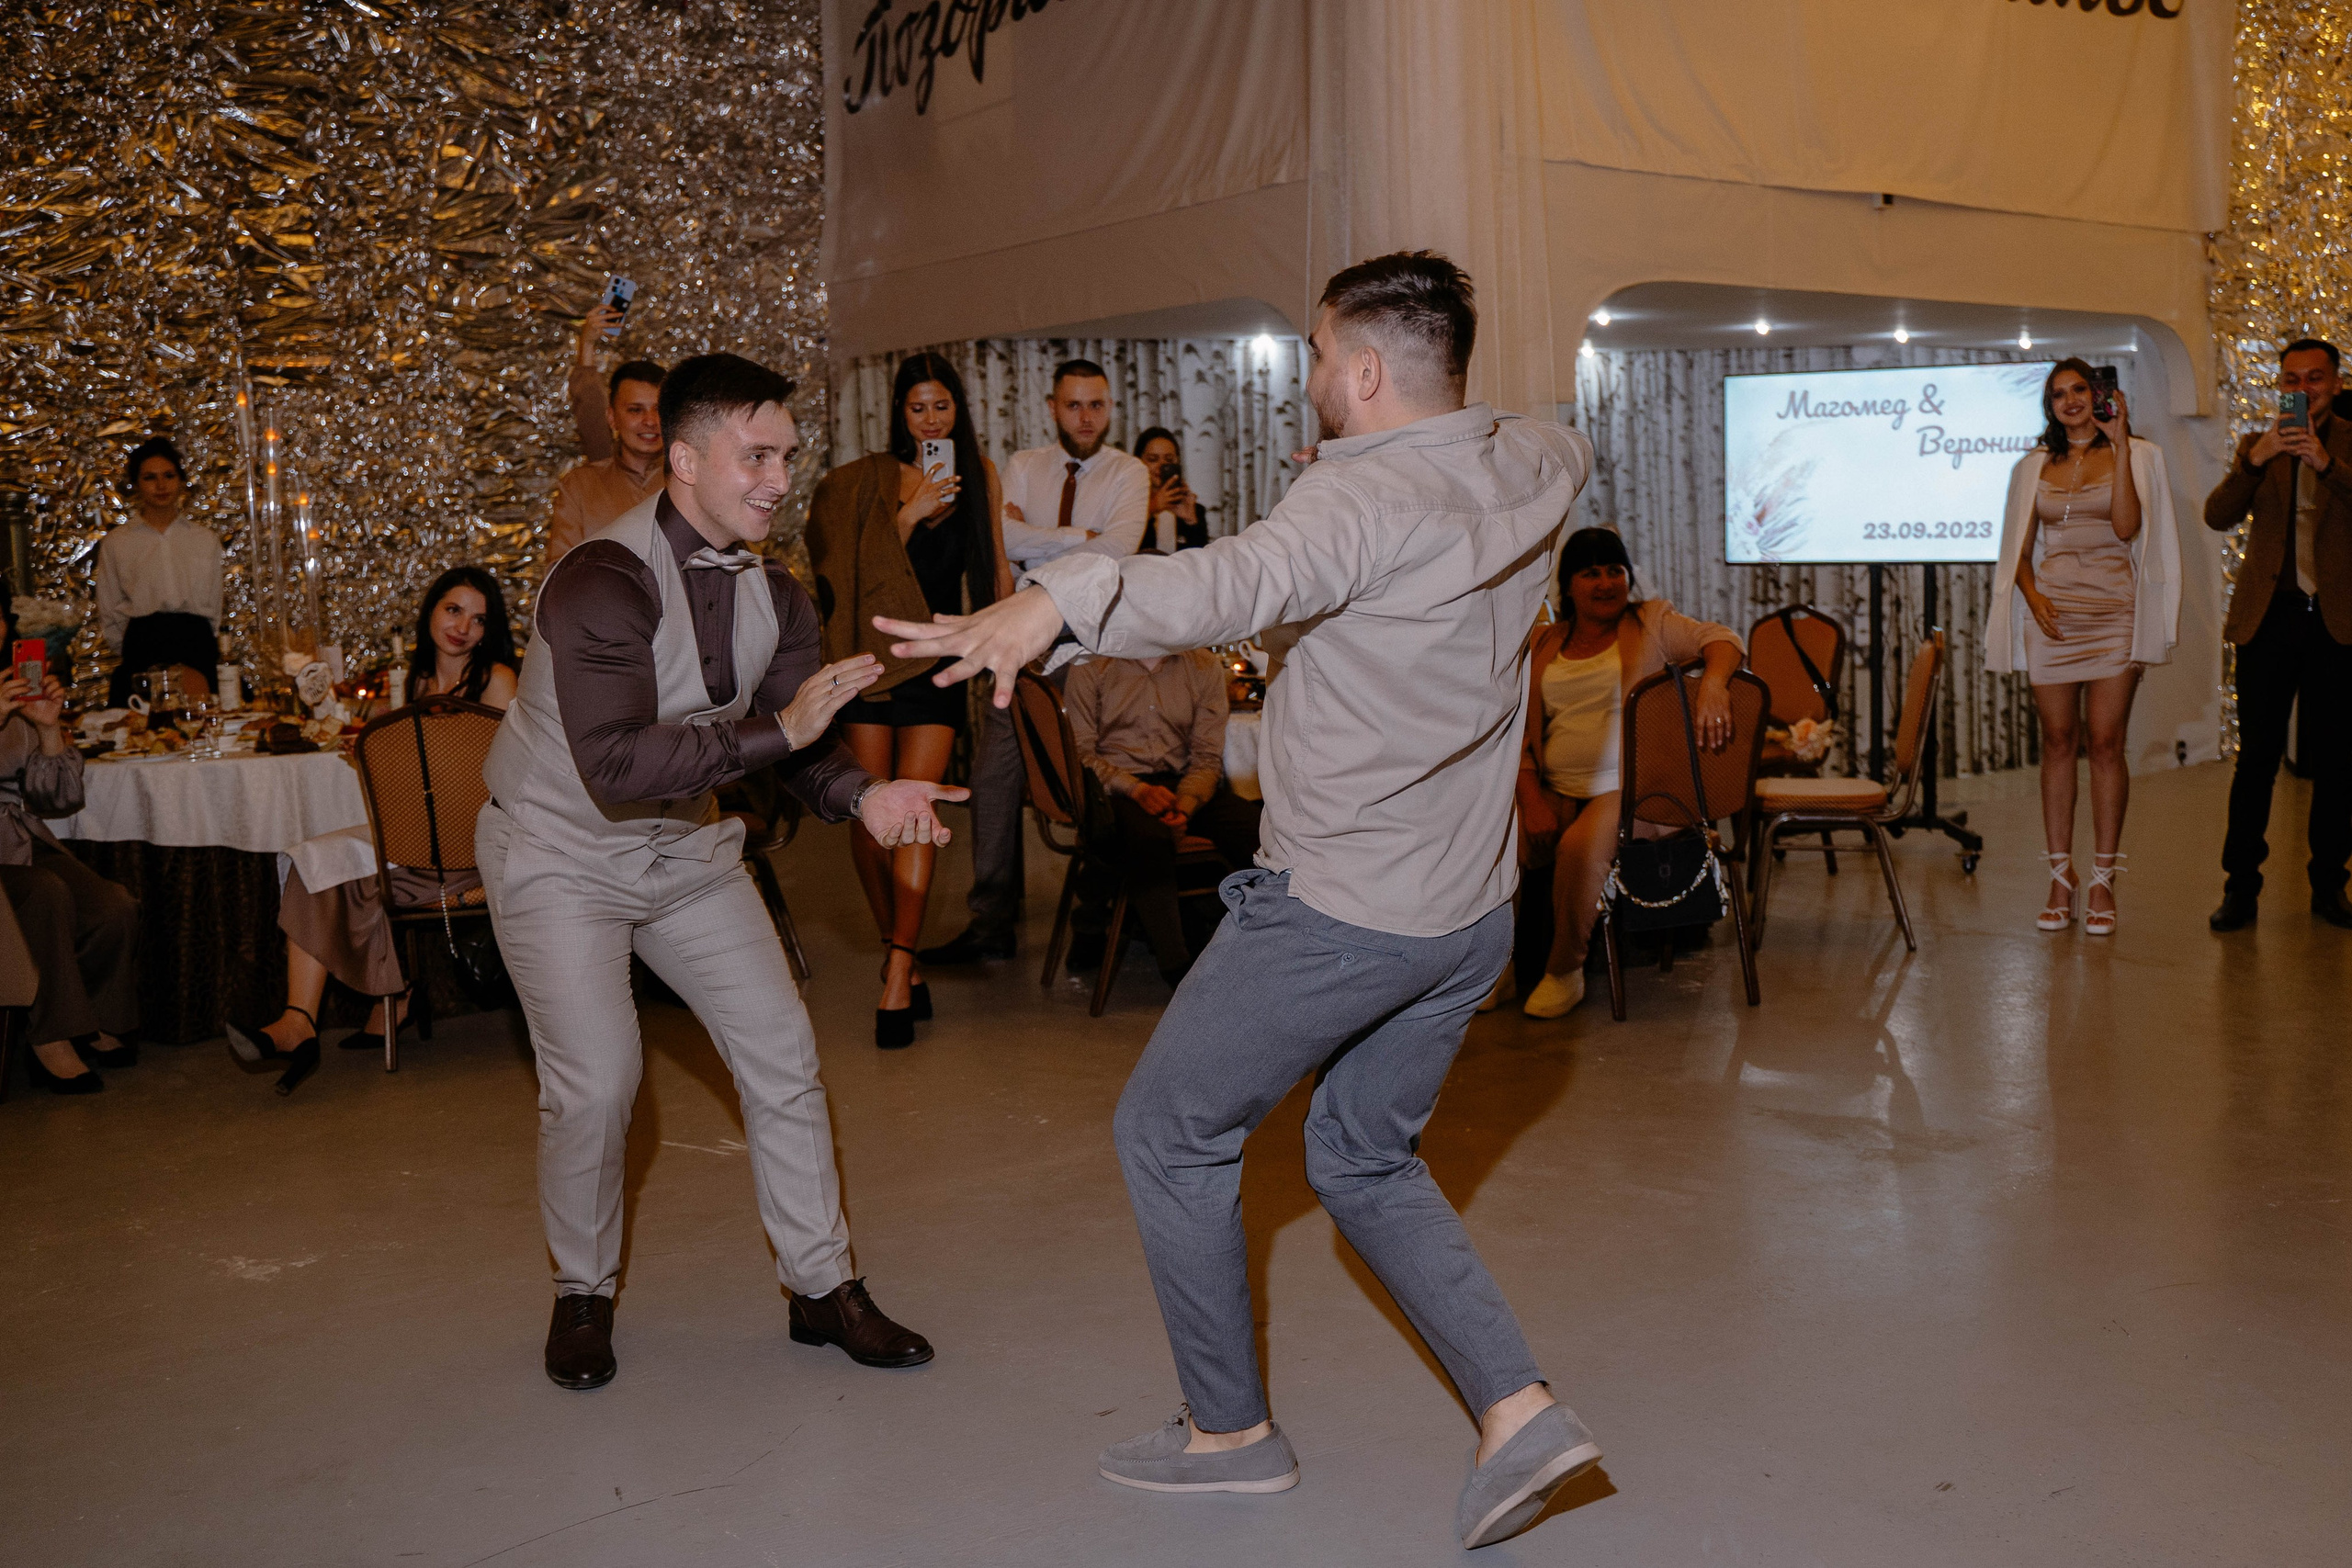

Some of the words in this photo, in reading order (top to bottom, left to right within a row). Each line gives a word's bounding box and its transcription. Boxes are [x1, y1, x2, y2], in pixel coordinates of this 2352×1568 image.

[1776, 389, 1910, 430] Магомед
[1918, 383, 1944, 415] &
[1862, 521, 1993, 540] 23.09.2023
